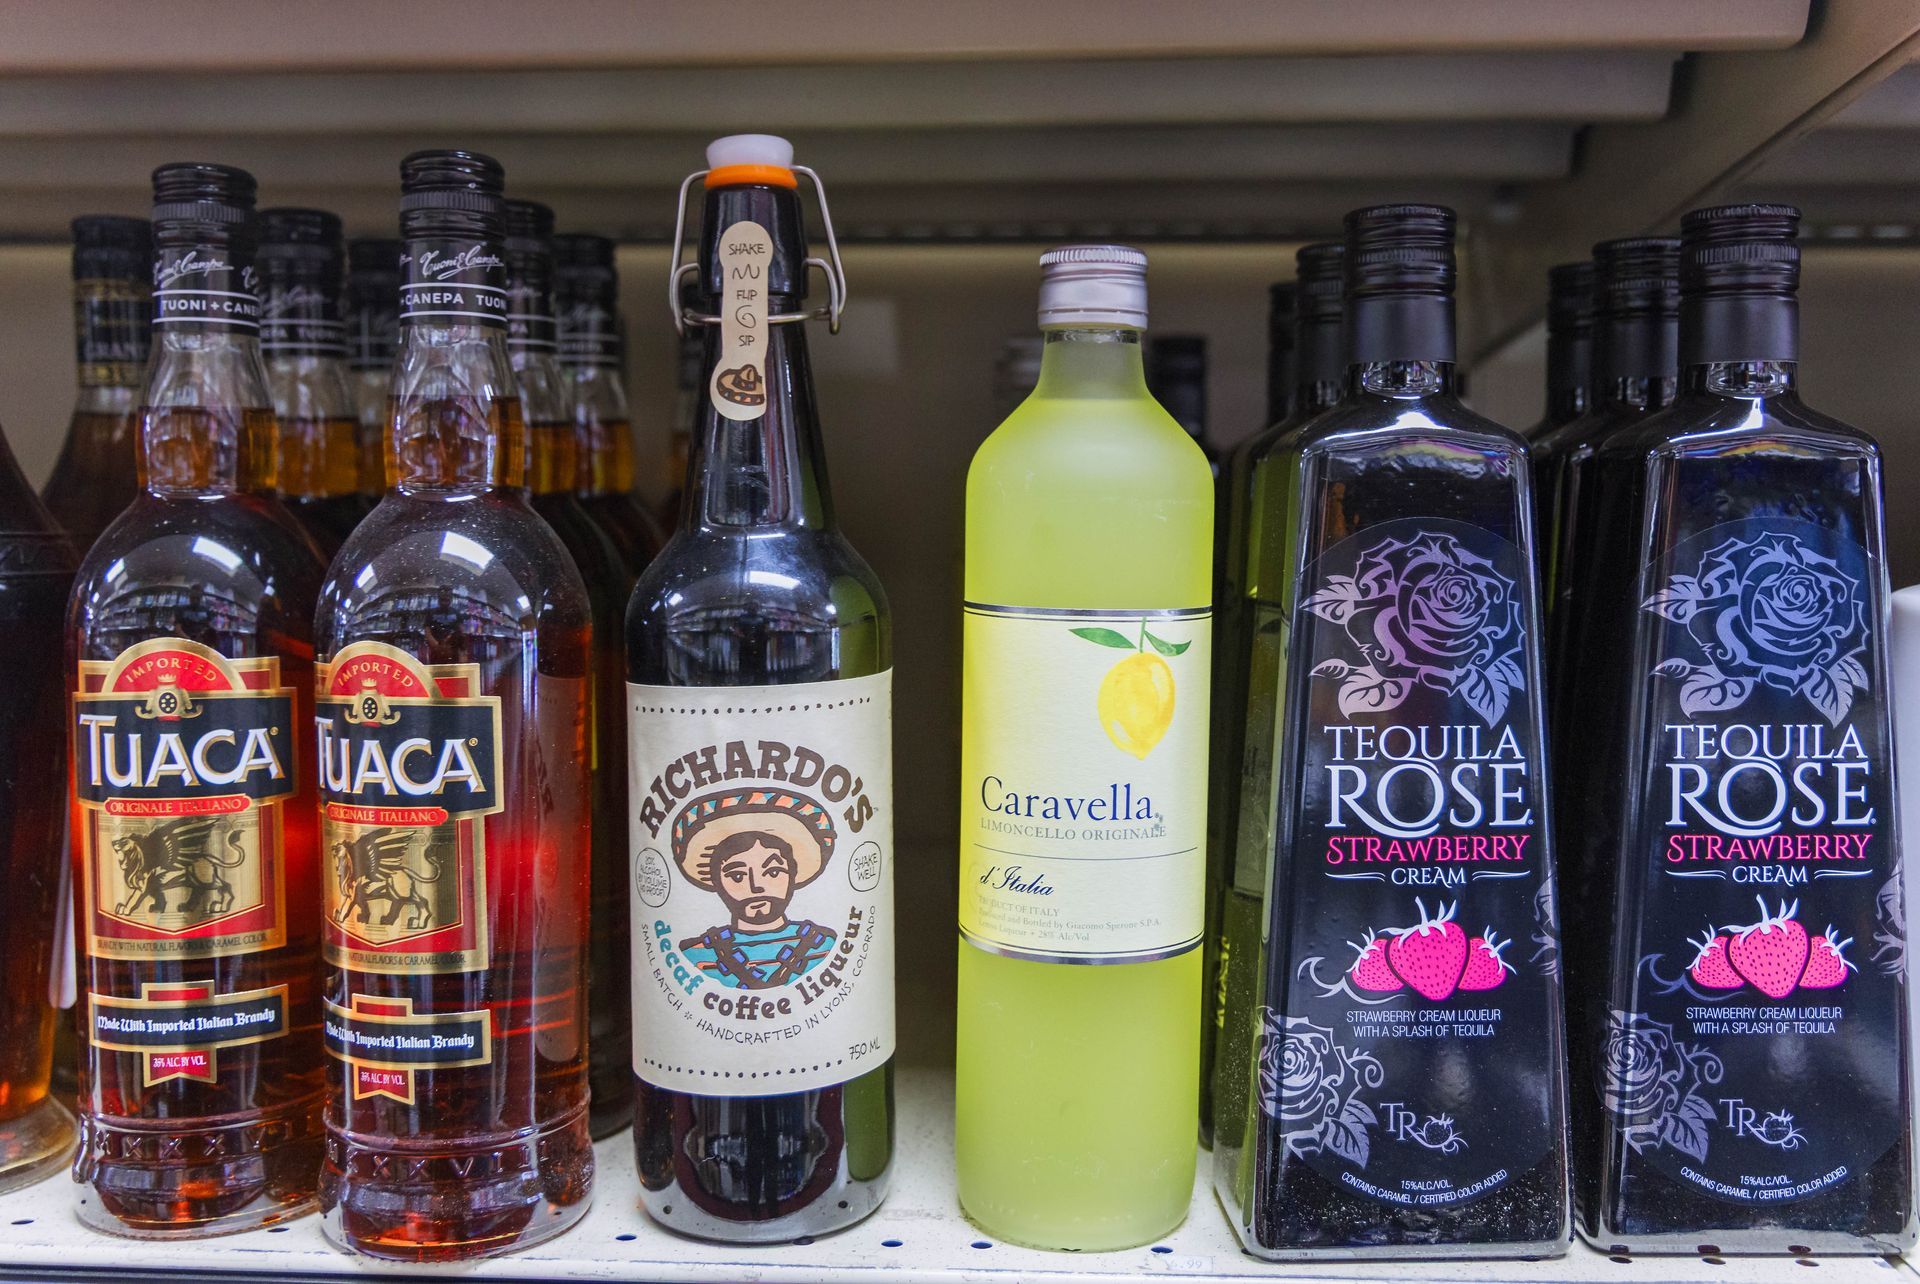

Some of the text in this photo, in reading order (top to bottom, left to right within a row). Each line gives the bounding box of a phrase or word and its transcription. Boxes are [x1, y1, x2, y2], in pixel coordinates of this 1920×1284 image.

[729, 243, 765, 255] SHAKE
[162, 299, 206, 311] TUONI
[405, 293, 464, 305] CANEPA
[736, 290, 758, 300] FLIP
[738, 335, 755, 346] SIP
[126, 657, 217, 683] IMPORTED
[338, 662, 414, 687] IMPORTED
[79, 714, 286, 788] TUACA
[315, 716, 487, 795] TUACA
[1324, 724, 1525, 773] TEQUILA
[1665, 723, 1868, 772] TEQUILA
[639, 740, 874, 839] RICHARDO'S
[981, 776, 1154, 821] Caravella
[1324, 762, 1533, 838] ROSE
[1665, 761, 1873, 836] ROSE
[110, 798, 242, 813] ORIGINALE ITALIANO
[380, 811, 438, 822] ITALIANO
[980, 817, 1167, 841] LIMONCELLO ORIGINALE
[1326, 835, 1530, 865] STRAWBERRY
[1667, 834, 1873, 862] STRAWBERRY
[853, 852, 878, 871] SHAKE
[857, 866, 877, 881] WELL
[980, 865, 1055, 897] d'Italia
[1391, 867, 1466, 888] CREAM
[1732, 864, 1808, 886] CREAM
[1029, 906, 1060, 917] ITALY
[654, 920, 704, 996] decaf
[795, 906, 864, 1006] liqueur
[641, 923, 656, 966] SMALL
[652, 968, 683, 1011] BATCH
[696, 1019, 802, 1045] HANDCRAFTED
[805, 1013, 820, 1029] IN
[853, 905, 876, 977] COLORADO
[703, 992, 792, 1020] coffee
[1346, 1009, 1501, 1022] STRAWBERRY CREAM LIQUEUR
[1686, 1007, 1842, 1019] STRAWBERRY CREAM LIQUEUR
[97, 1008, 275, 1035] Made With Imported Italian Brandy
[1353, 1024, 1494, 1037] WITH A SPLASH OF TEQUILA
[1693, 1022, 1835, 1034] WITH A SPLASH OF TEQUILA
[355, 1031, 395, 1048] Imported
[395, 1035, 431, 1049] Italian
[432, 1033, 474, 1048] Brandy
[848, 1037, 881, 1060] 750 ML
[1341, 1171, 1377, 1195] CONTAINS
[1377, 1188, 1412, 1203] CARAMEL
[1420, 1191, 1456, 1204] CERTIFIED
[1457, 1182, 1483, 1198] COLOR
[1484, 1169, 1507, 1188] ADDED
[1680, 1166, 1715, 1189] CONTAINS
[1715, 1183, 1751, 1199] CARAMEL
[1758, 1187, 1795, 1200] CERTIFIED
[1797, 1178, 1823, 1194] COLOR
[1823, 1165, 1847, 1186] ADDED
